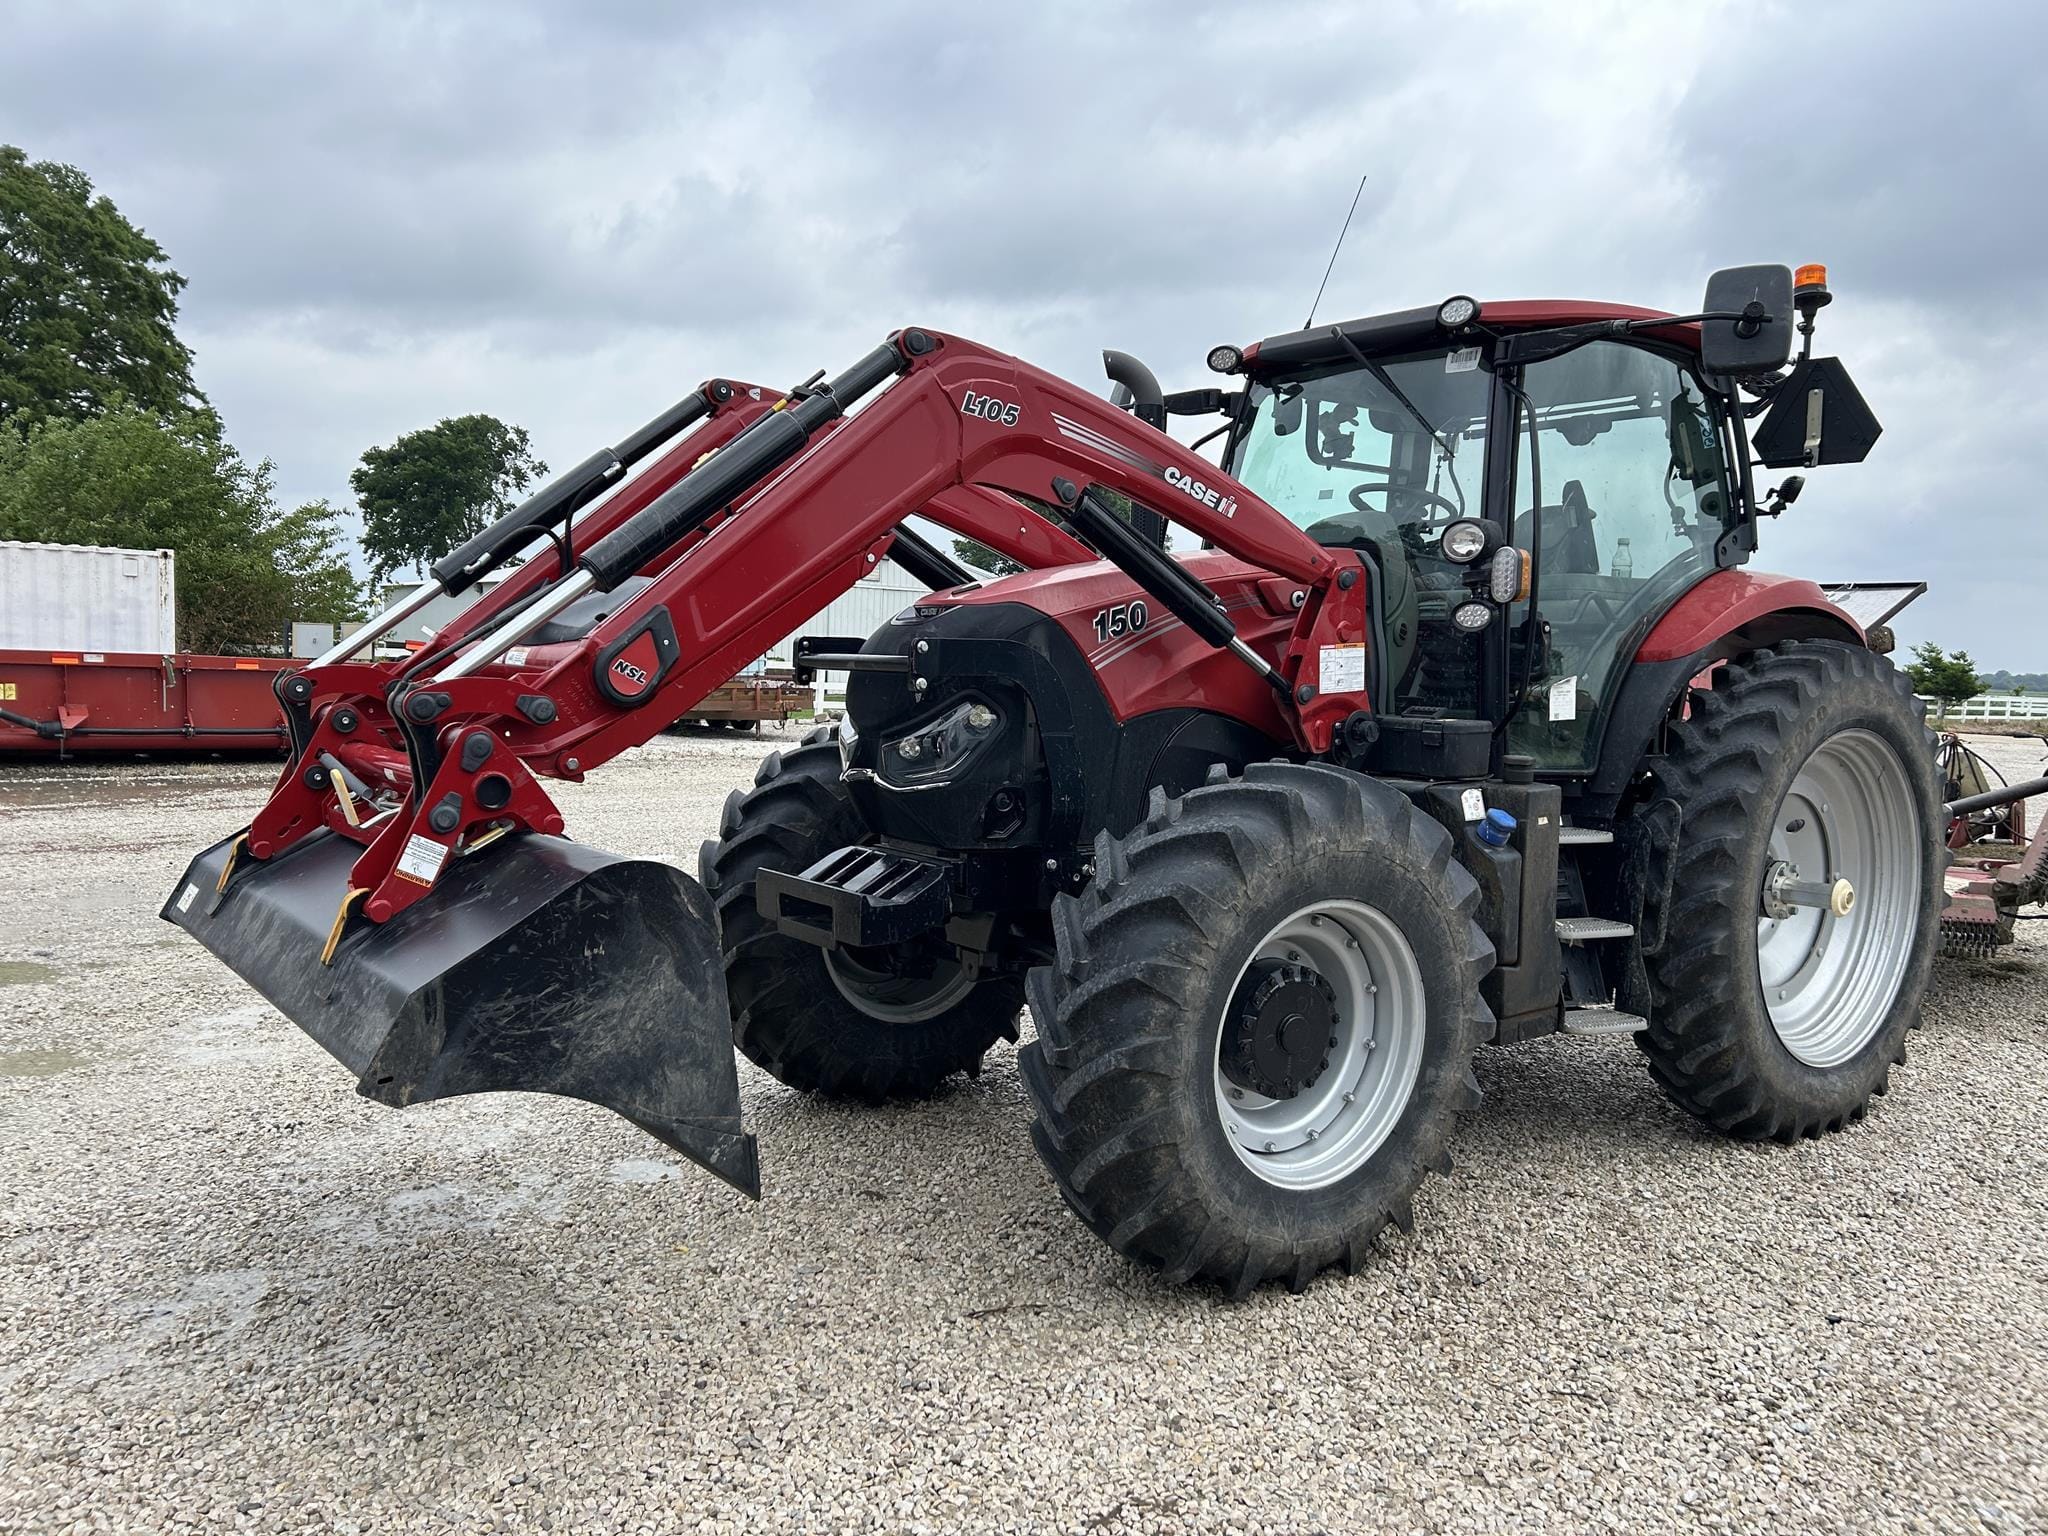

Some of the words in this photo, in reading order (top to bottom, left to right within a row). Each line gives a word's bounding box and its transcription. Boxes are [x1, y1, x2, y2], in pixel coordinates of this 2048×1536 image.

[960, 390, 1021, 427] L105
[1163, 466, 1218, 509] CASE
[1092, 600, 1149, 644] 150
[613, 659, 648, 686] NSL
